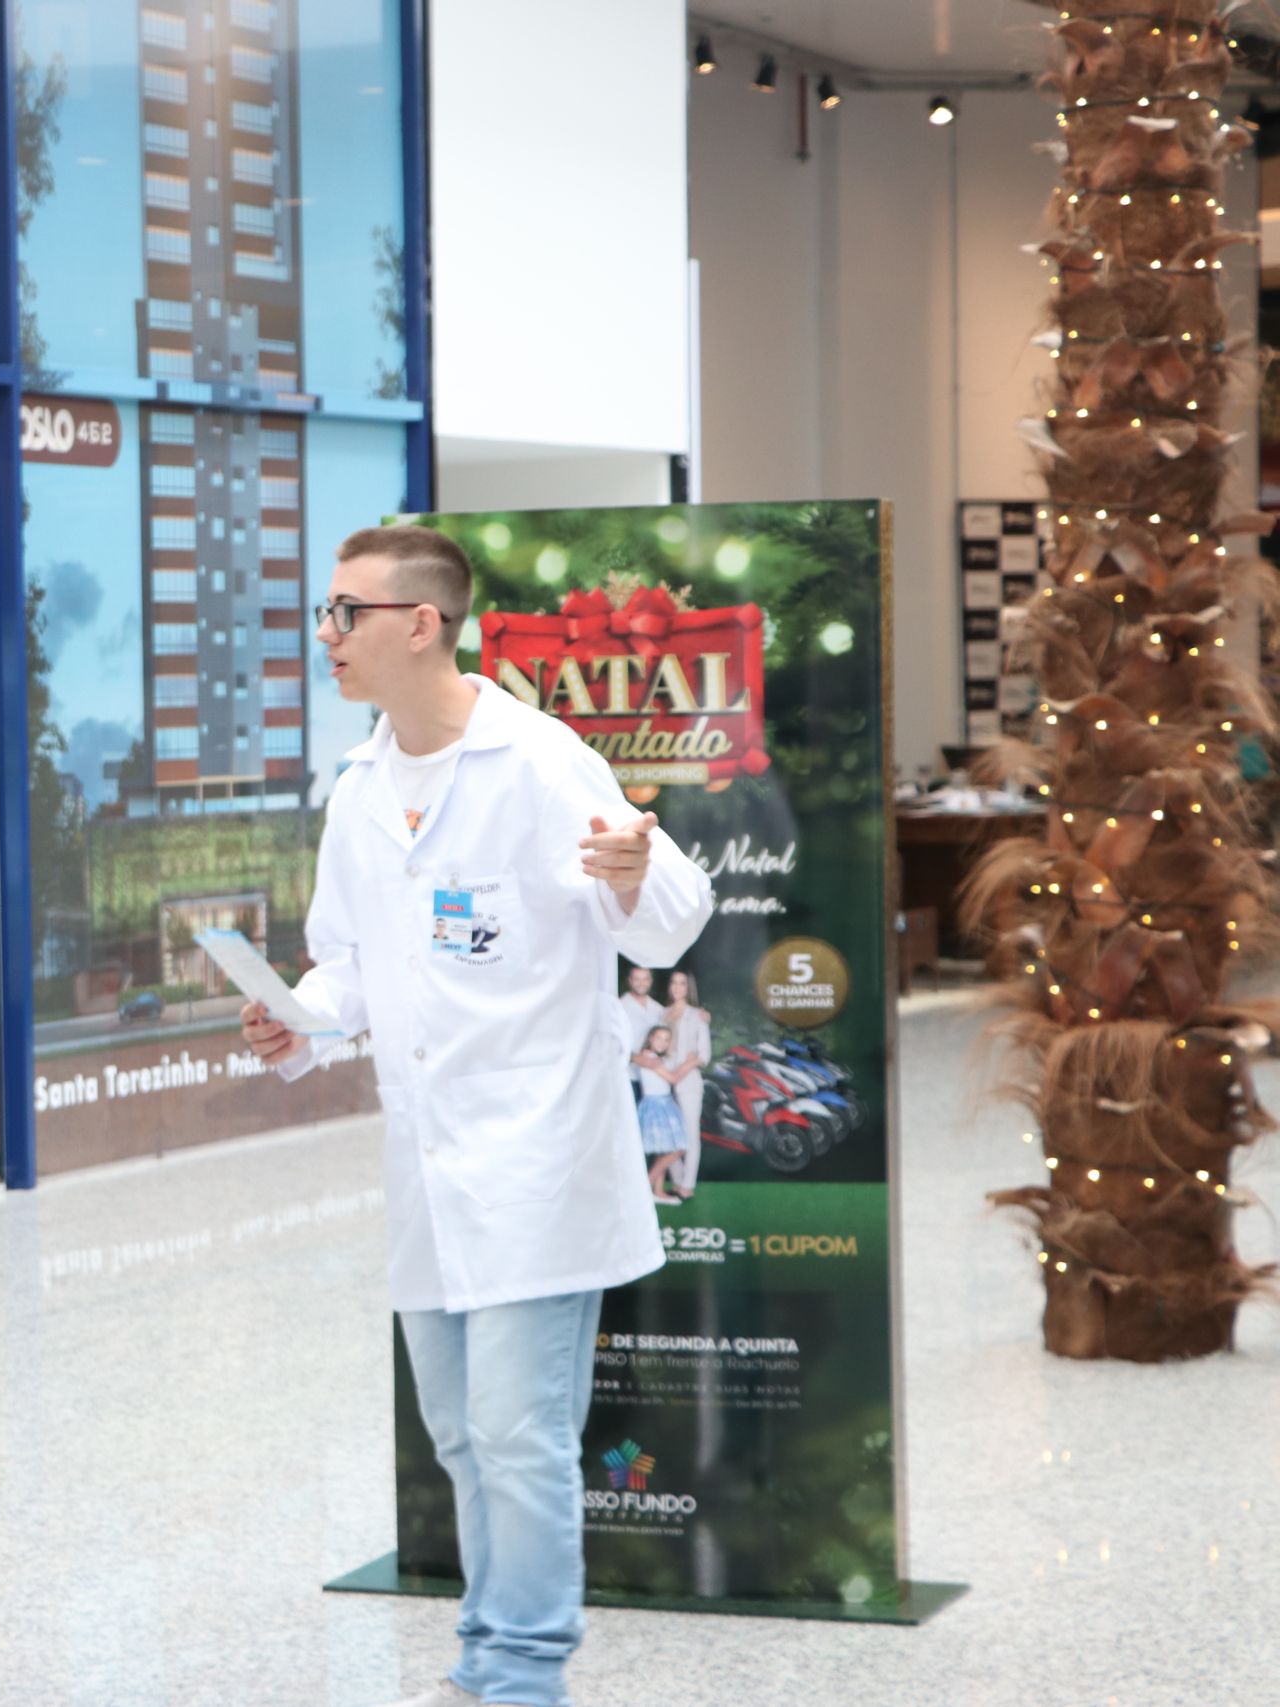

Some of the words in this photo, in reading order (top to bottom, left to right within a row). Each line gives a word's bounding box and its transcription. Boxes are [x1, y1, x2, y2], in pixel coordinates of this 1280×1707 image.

[494, 653, 751, 715] NATAL
[583, 715, 733, 760] antado
[633, 769, 704, 782] SHOPPING
[708, 833, 796, 878] Natal
[789, 953, 814, 984] 5
[768, 984, 834, 997] CHANCES
[34, 1075, 99, 1112] Santa
[103, 1050, 209, 1099] Terezinha
[679, 1227, 726, 1248] 250
[750, 1236, 761, 1254] 1
[764, 1236, 858, 1257] CUPOM
[613, 1334, 634, 1349] DE
[637, 1335, 715, 1351] SEGUNDA
[720, 1338, 732, 1351] A
[734, 1338, 800, 1356] QUINTA
[590, 1511, 683, 1522] HOPPING
[622, 1491, 697, 1514] FUNDO
